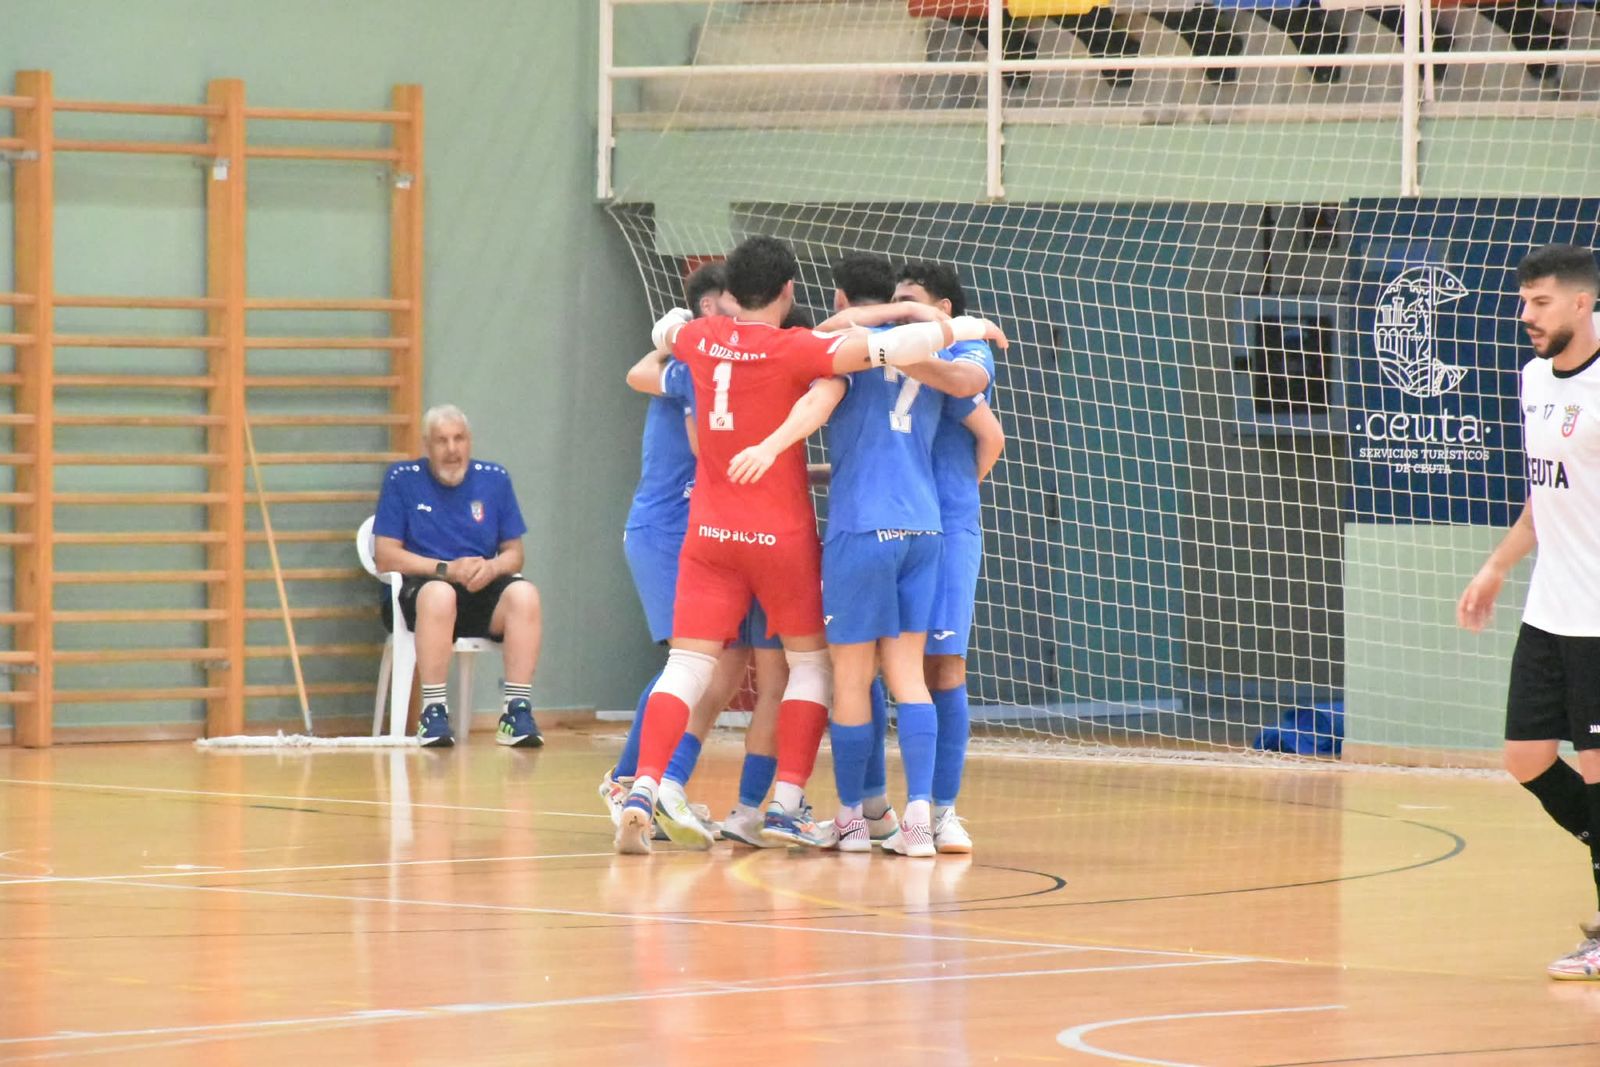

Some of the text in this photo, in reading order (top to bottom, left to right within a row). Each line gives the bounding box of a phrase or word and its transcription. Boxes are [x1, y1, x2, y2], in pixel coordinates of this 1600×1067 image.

[708, 360, 735, 432] 1
[884, 364, 922, 433] 7
[1543, 404, 1555, 420] 17
[1359, 447, 1419, 460] SERVICIOS
[1395, 462, 1453, 475] DE CEUTA
[1527, 457, 1570, 489] EUTA
